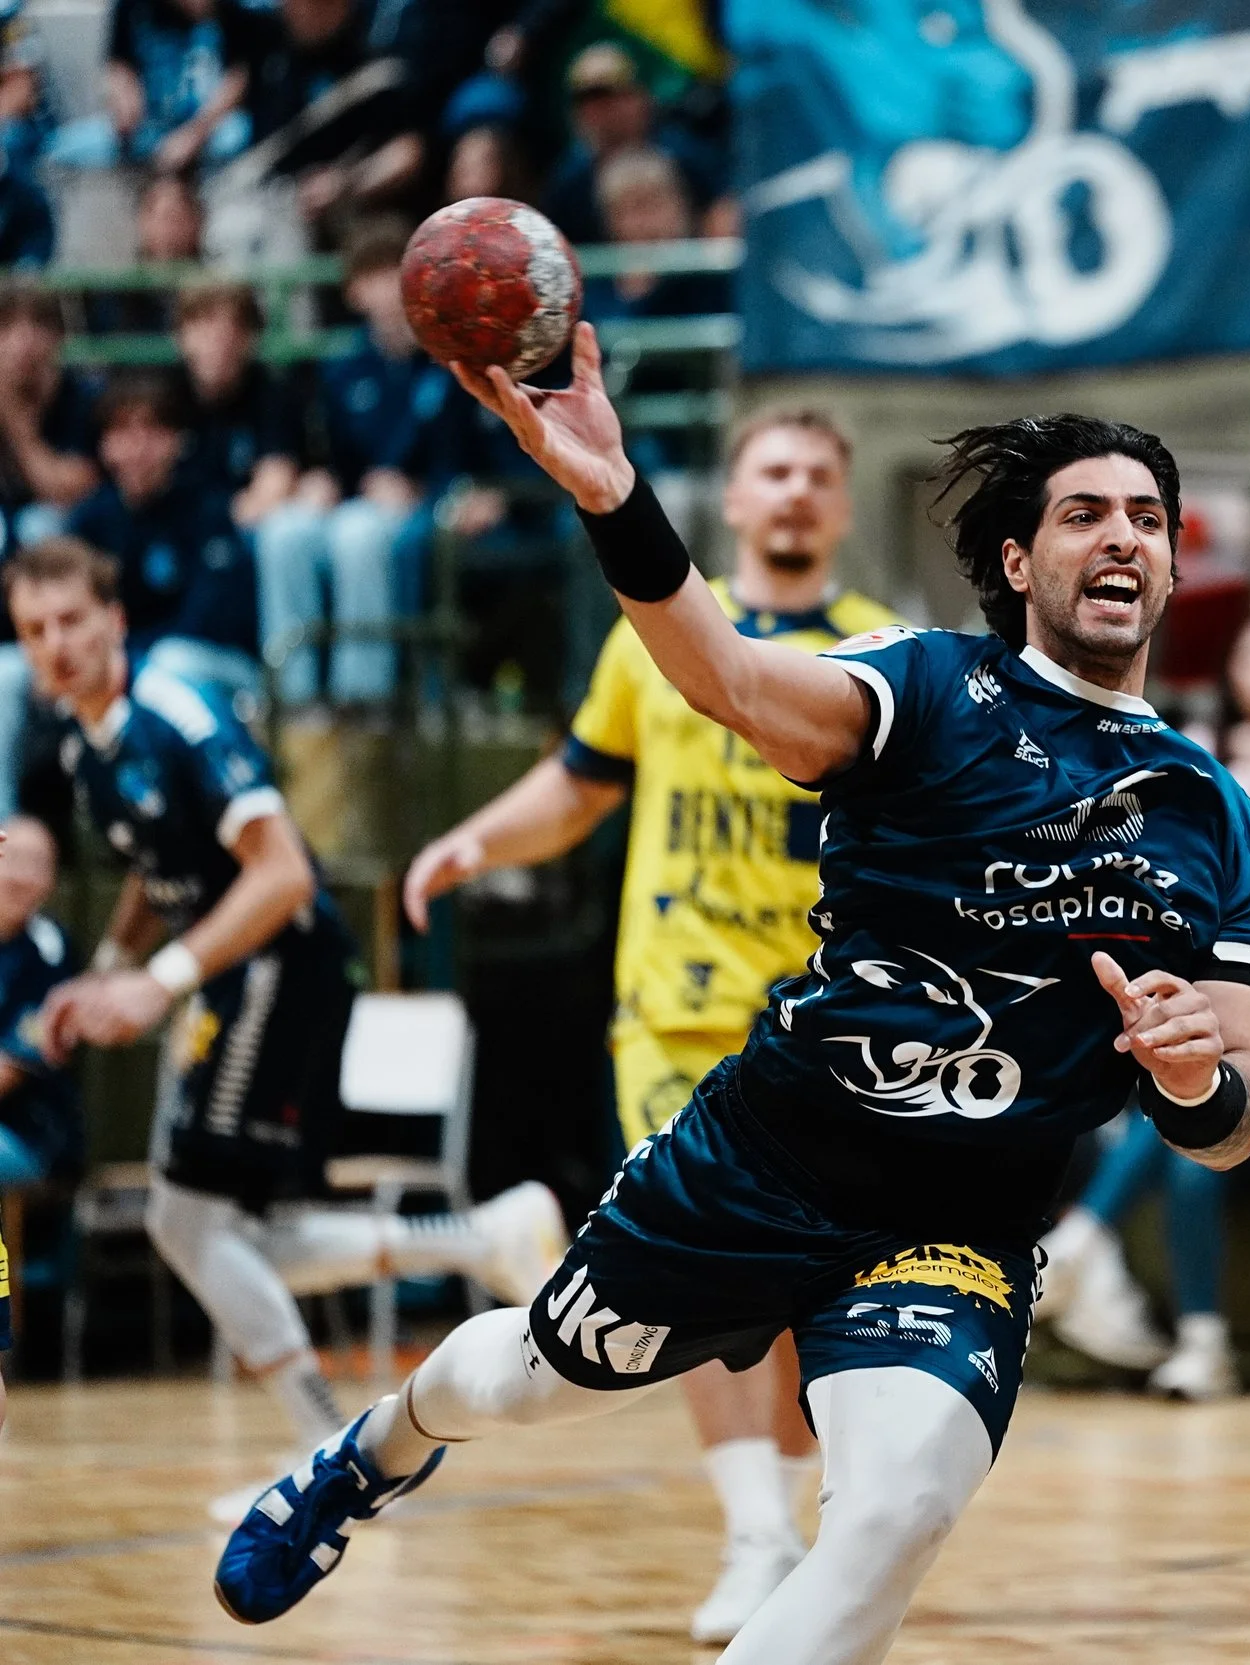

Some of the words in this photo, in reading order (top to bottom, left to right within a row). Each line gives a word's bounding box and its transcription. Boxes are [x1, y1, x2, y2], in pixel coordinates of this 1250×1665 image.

[1014, 746, 1049, 769] SELECT
[954, 886, 1197, 931] kosaplane
[547, 1263, 622, 1365] JK
[625, 1326, 659, 1372] CONSULTING
[967, 1353, 1000, 1394] SELECT
